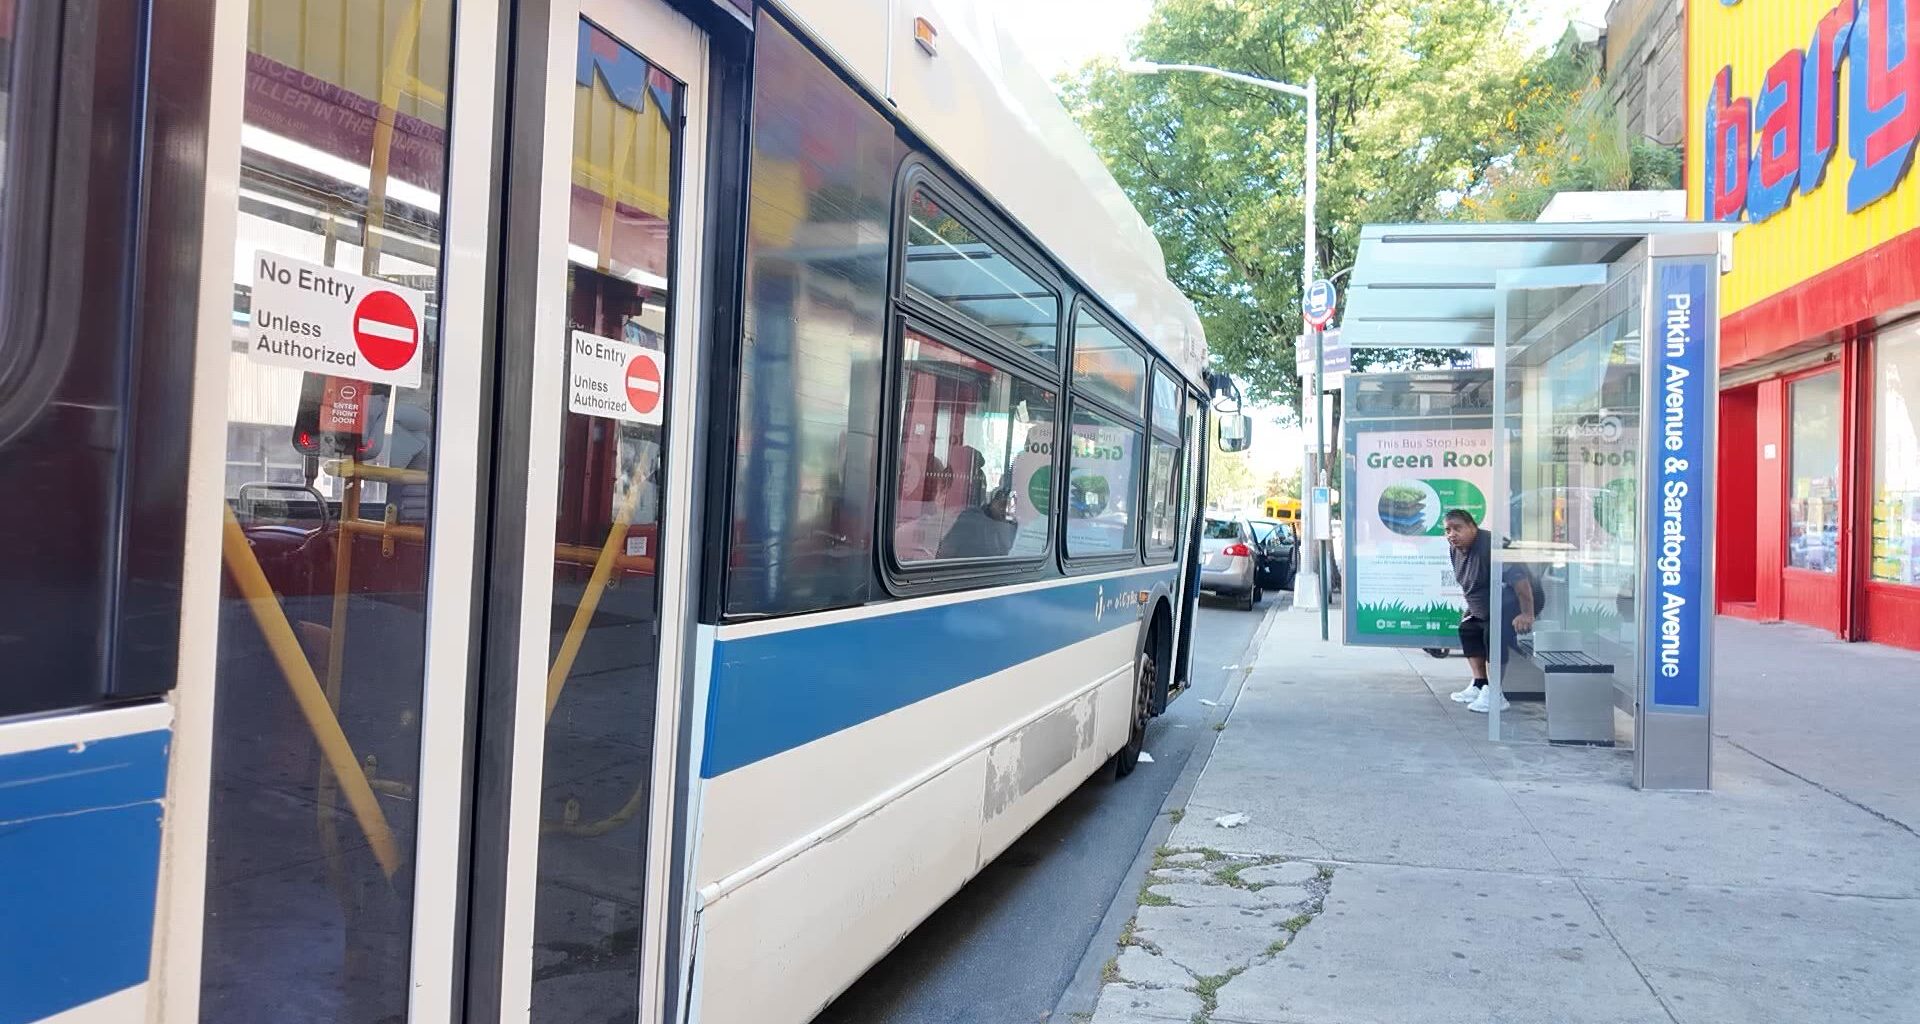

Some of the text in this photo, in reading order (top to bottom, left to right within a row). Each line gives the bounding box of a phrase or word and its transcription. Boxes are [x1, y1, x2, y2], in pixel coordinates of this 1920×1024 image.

[260, 258, 355, 304] No Entry
[257, 309, 321, 338] Unless
[256, 334, 356, 367] Authorized
[575, 338, 626, 367] No Entry
[574, 374, 609, 393] Unless
[332, 402, 359, 411] ENTER
[573, 392, 627, 412] Authorized
[331, 409, 358, 418] FRONT
[331, 416, 356, 424] DOOR
[1376, 437, 1487, 450] This Bus Stop Has a
[1367, 452, 1434, 469] Green
[1657, 293, 1690, 678] Pitkin Avenue & Saratoga Avenue
